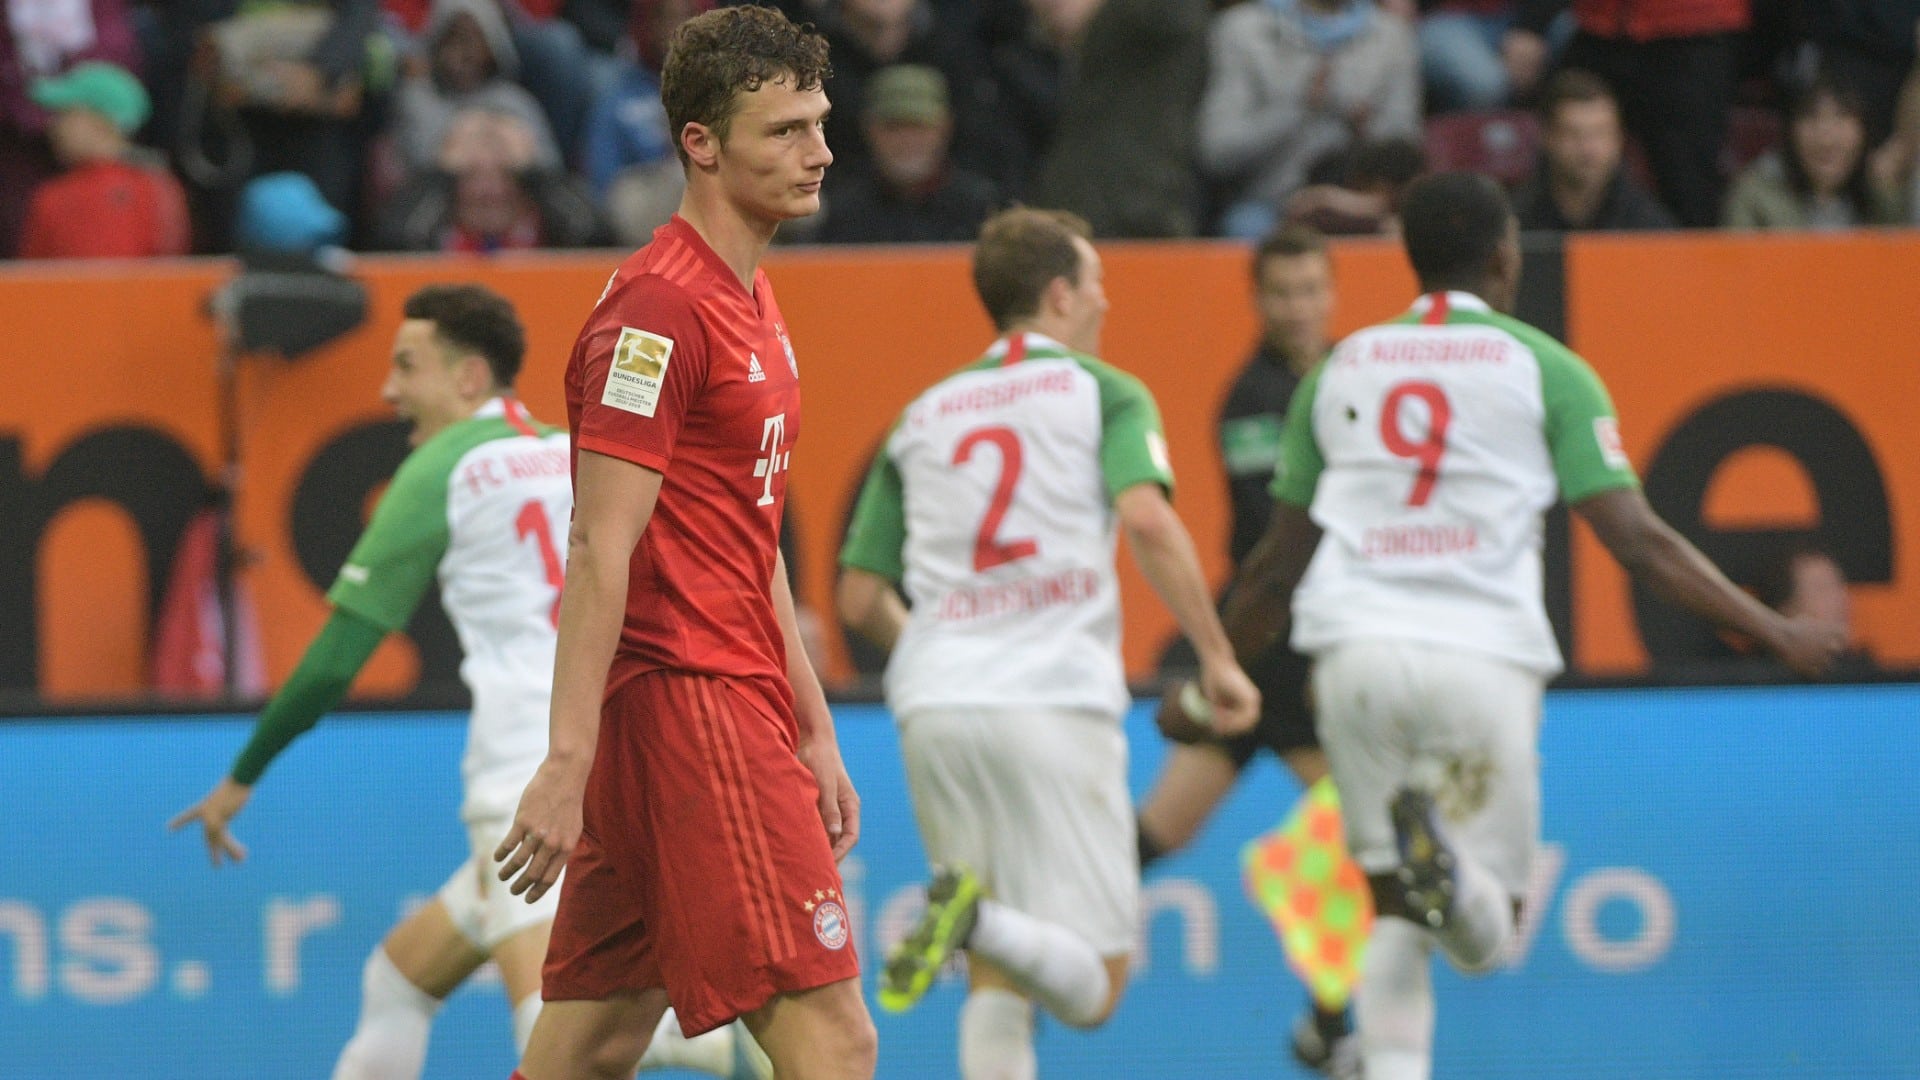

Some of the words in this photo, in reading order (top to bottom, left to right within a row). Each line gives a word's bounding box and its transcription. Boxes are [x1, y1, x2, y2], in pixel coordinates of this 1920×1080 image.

[1368, 337, 1512, 364] AUGSBURG
[612, 371, 657, 389] BUNDESLIGA
[1379, 381, 1451, 507] 9
[464, 458, 505, 494] FC
[504, 450, 571, 479] AUGS
[951, 425, 1038, 572] 2
[1361, 525, 1479, 557] CORDOVA
